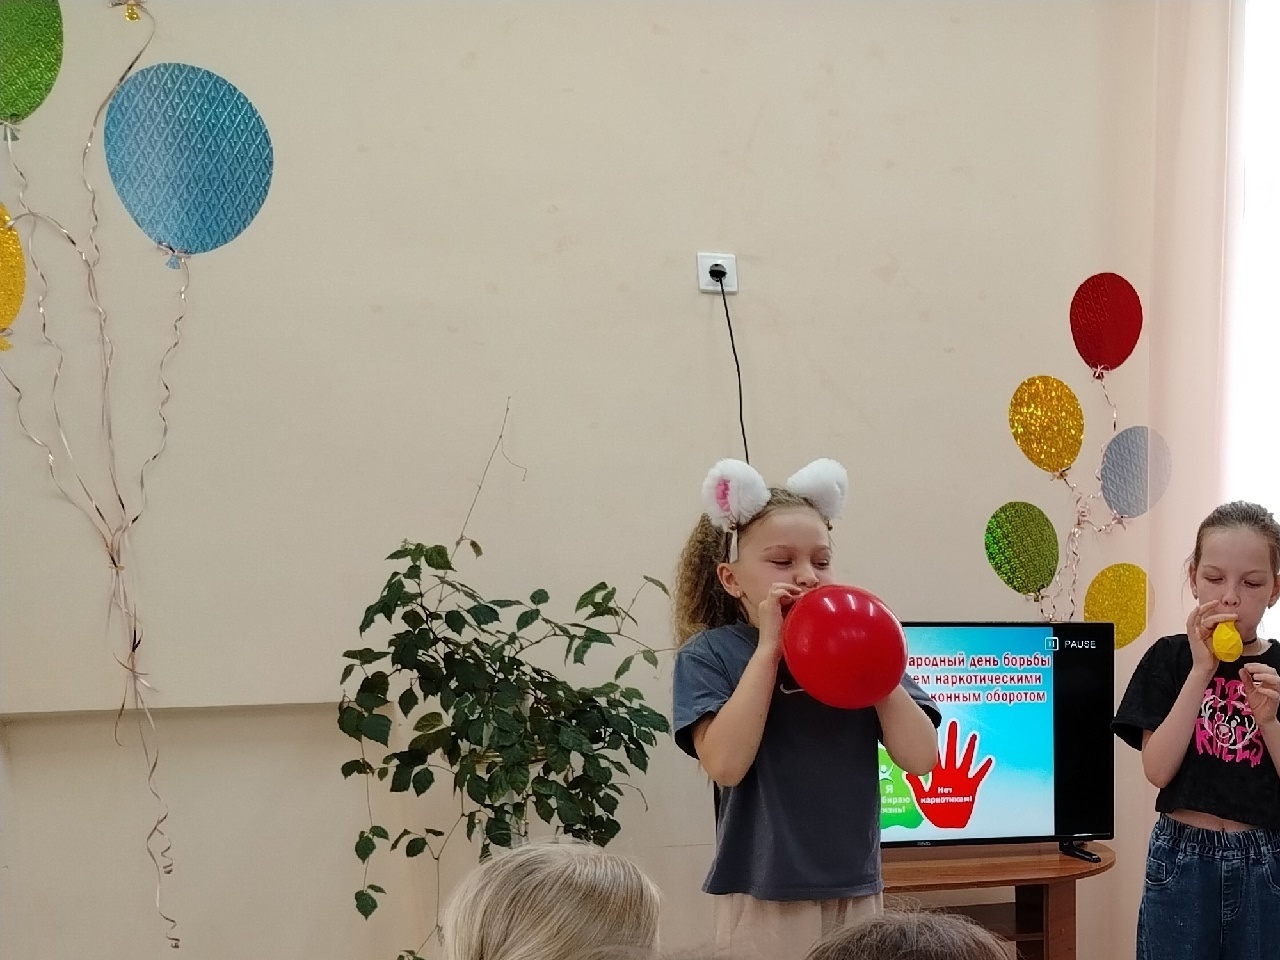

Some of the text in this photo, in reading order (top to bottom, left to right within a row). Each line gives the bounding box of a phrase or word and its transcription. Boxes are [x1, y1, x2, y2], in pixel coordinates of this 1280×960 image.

[1064, 640, 1097, 649] PAUSE
[908, 652, 1050, 670] ародный день борьбы
[935, 674, 1042, 687] наркотическими
[930, 689, 1046, 704] конным оборотом
[886, 784, 894, 794] Я
[937, 786, 953, 794] Нет
[881, 796, 910, 805] бираю
[920, 796, 973, 805] наркотикам!
